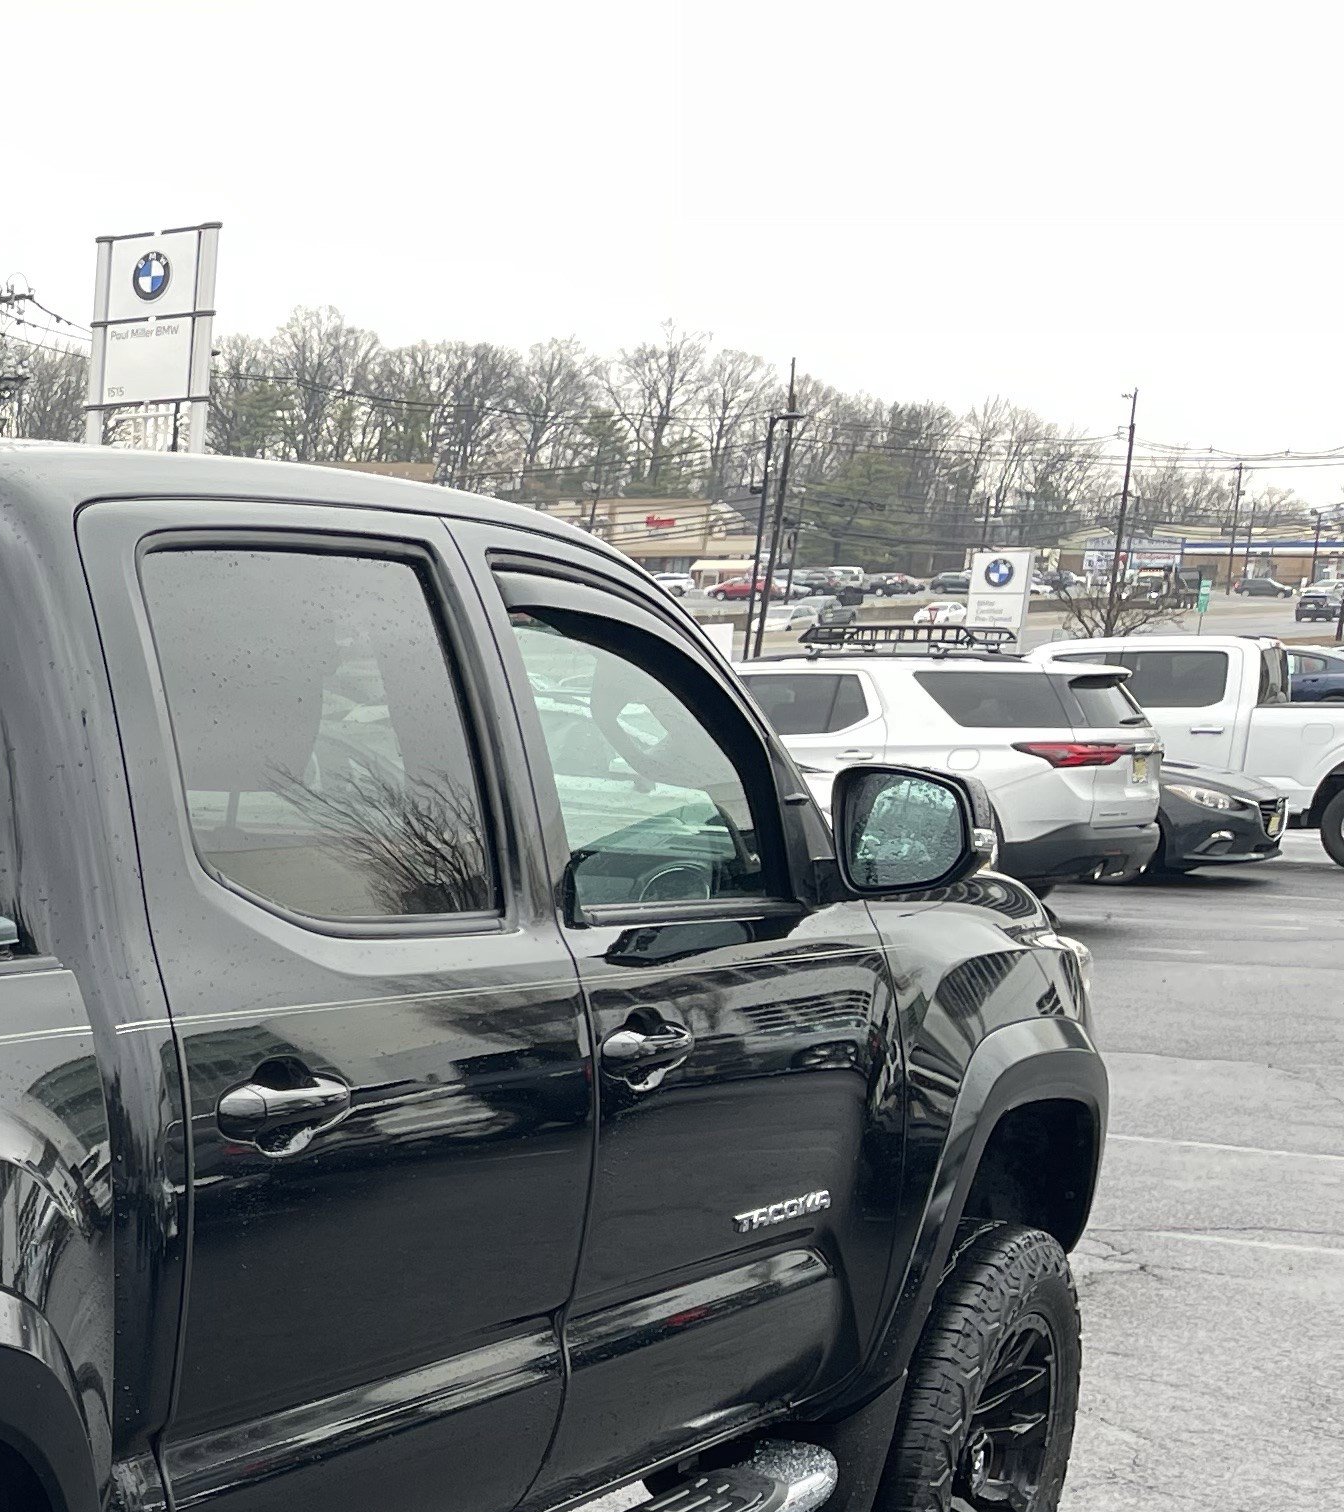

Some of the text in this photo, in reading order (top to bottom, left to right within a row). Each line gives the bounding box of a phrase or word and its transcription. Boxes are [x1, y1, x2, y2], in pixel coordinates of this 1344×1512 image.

[110, 325, 180, 341] Paul Miller BMW
[732, 1189, 832, 1233] TACOMA
